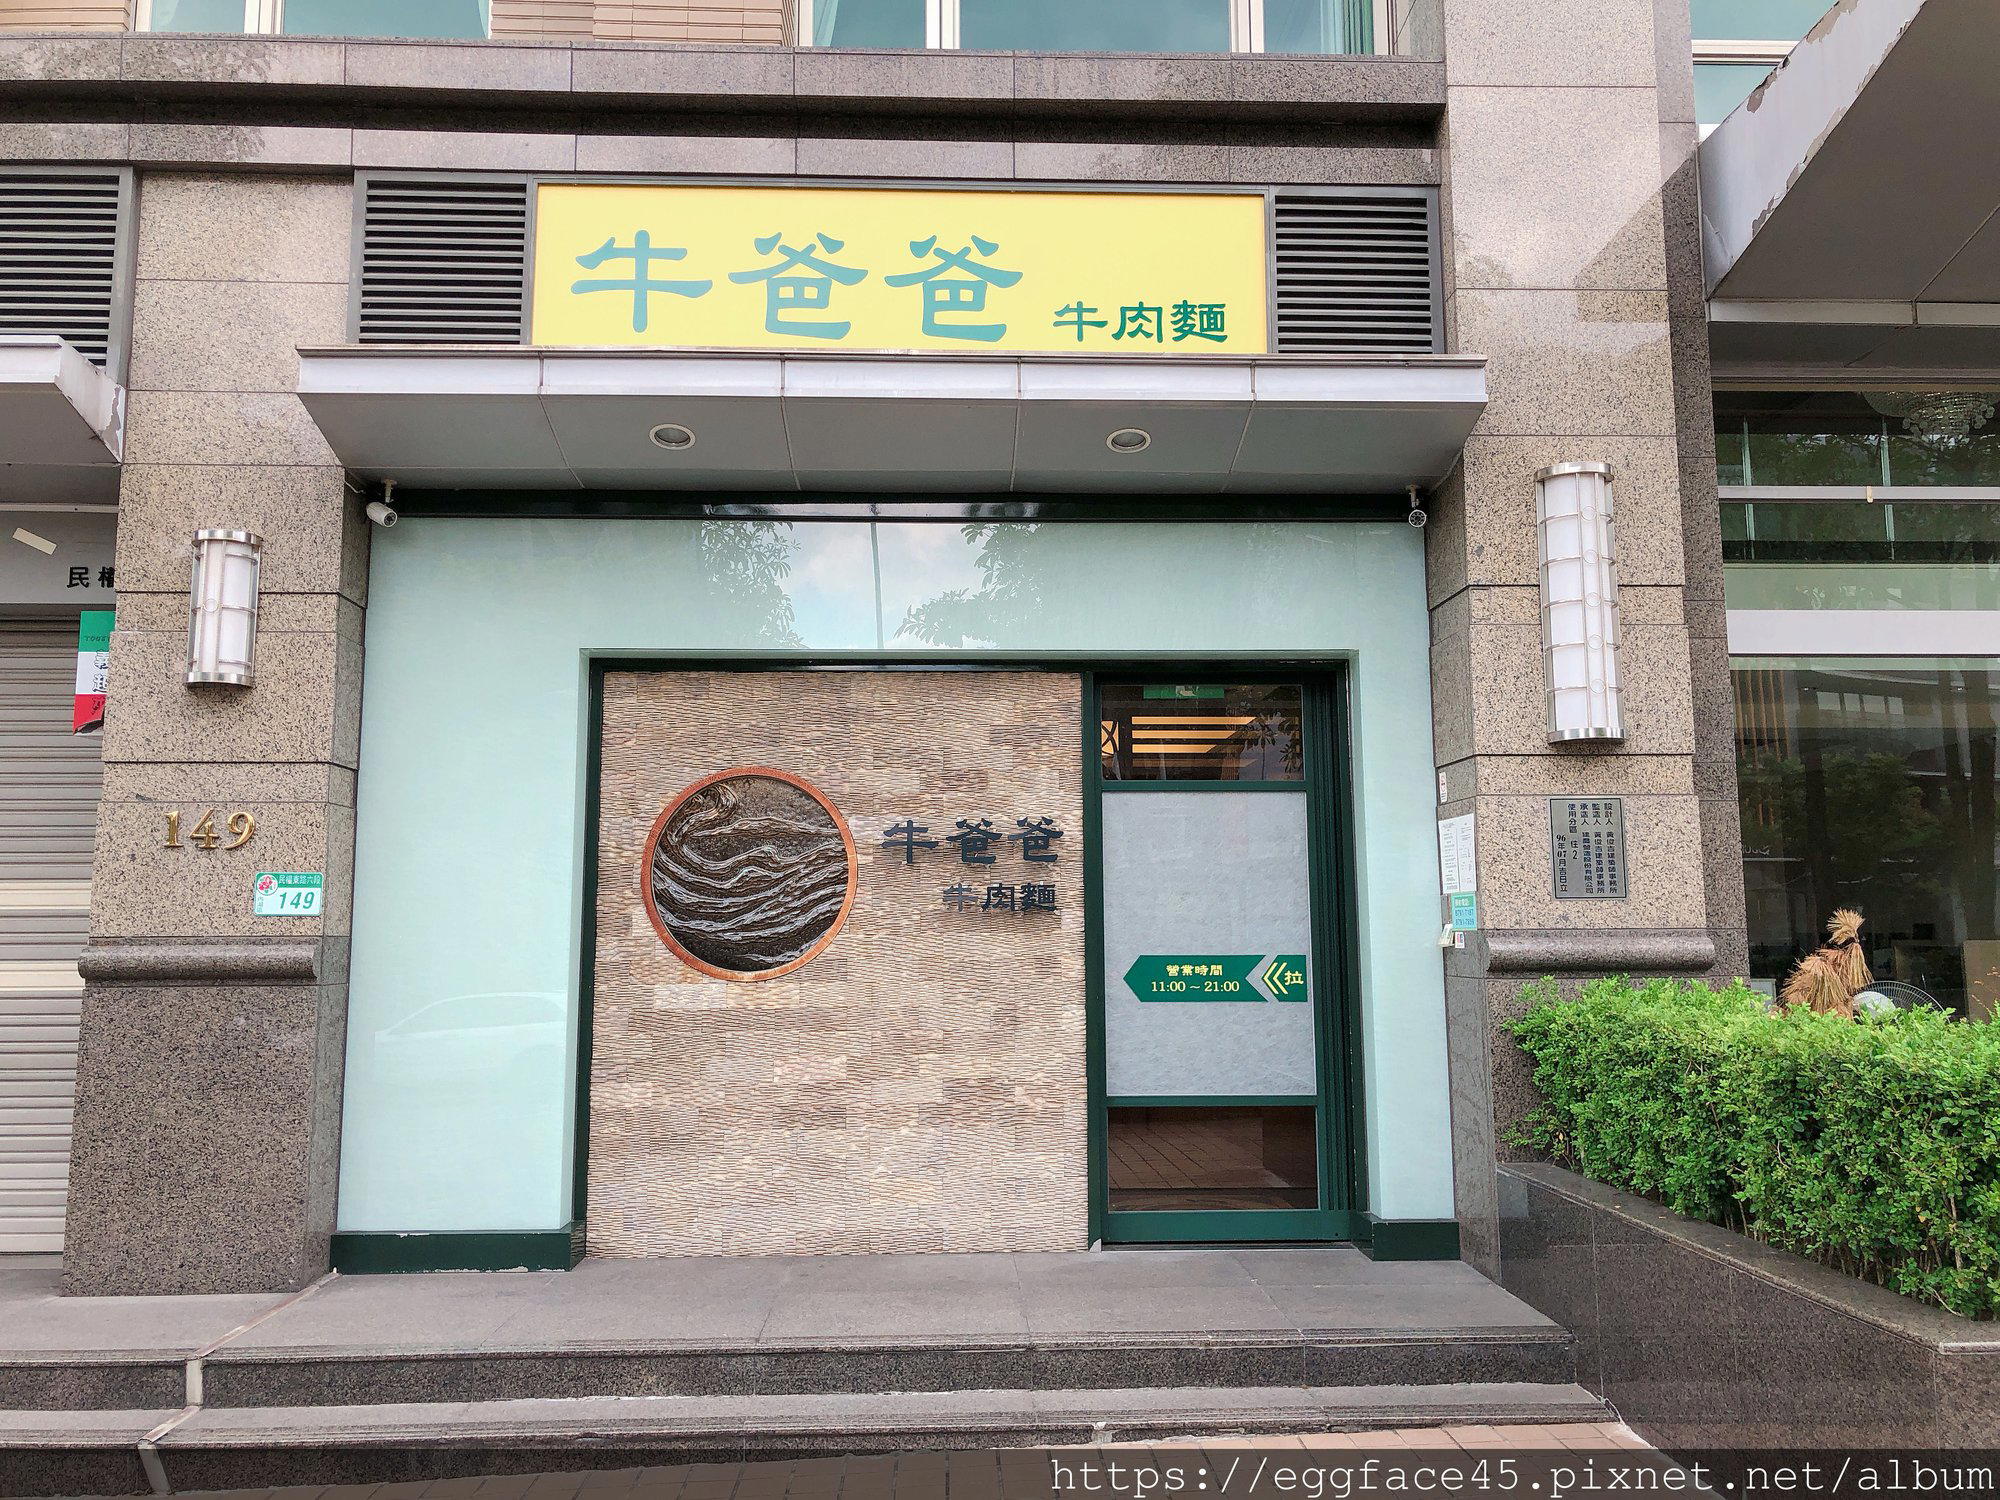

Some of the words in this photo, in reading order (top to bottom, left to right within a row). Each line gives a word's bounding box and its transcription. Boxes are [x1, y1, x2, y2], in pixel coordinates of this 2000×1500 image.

[571, 229, 1024, 342] 牛爸爸
[1053, 300, 1229, 343] 牛肉麵
[1580, 803, 1590, 826] 承造人
[1604, 803, 1614, 826] 設計人
[164, 810, 257, 850] 149
[881, 816, 1065, 865] 牛爸爸
[278, 874, 321, 885] 民權東路六段
[279, 891, 315, 909] 149
[942, 882, 1058, 912] 牛肉麵
[1166, 964, 1223, 976] 營業時間
[1284, 970, 1304, 985] 拉
[1151, 981, 1186, 992] 11:00
[1204, 981, 1240, 992] 21:00
